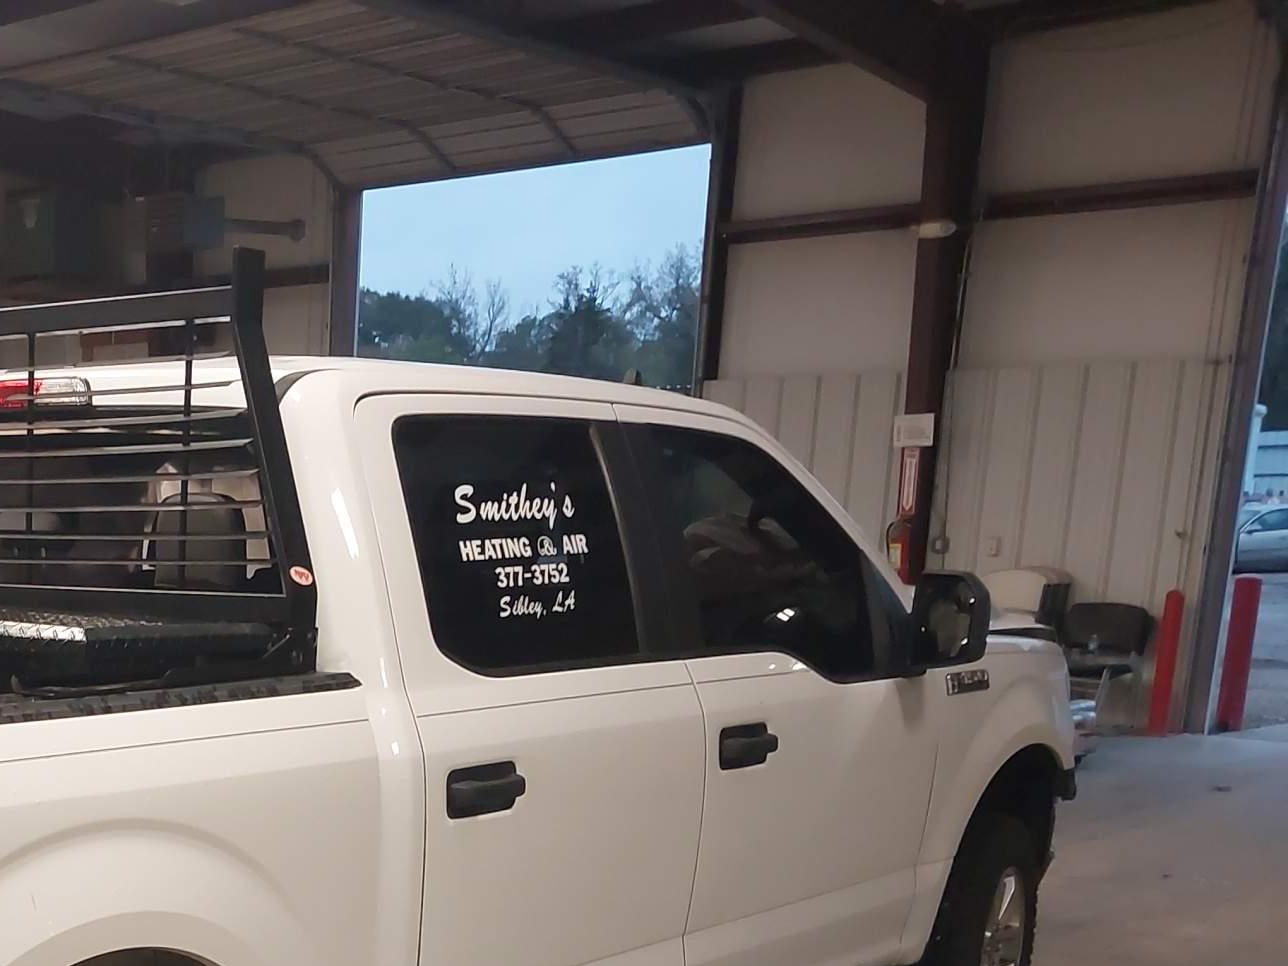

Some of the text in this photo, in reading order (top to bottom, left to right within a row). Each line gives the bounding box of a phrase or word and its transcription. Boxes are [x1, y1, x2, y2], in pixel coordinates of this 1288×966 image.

[454, 481, 575, 530] Smithey's
[458, 536, 533, 562] HEATING
[562, 533, 589, 555] AIR
[494, 563, 570, 588] 377-3752
[552, 590, 576, 613] LA
